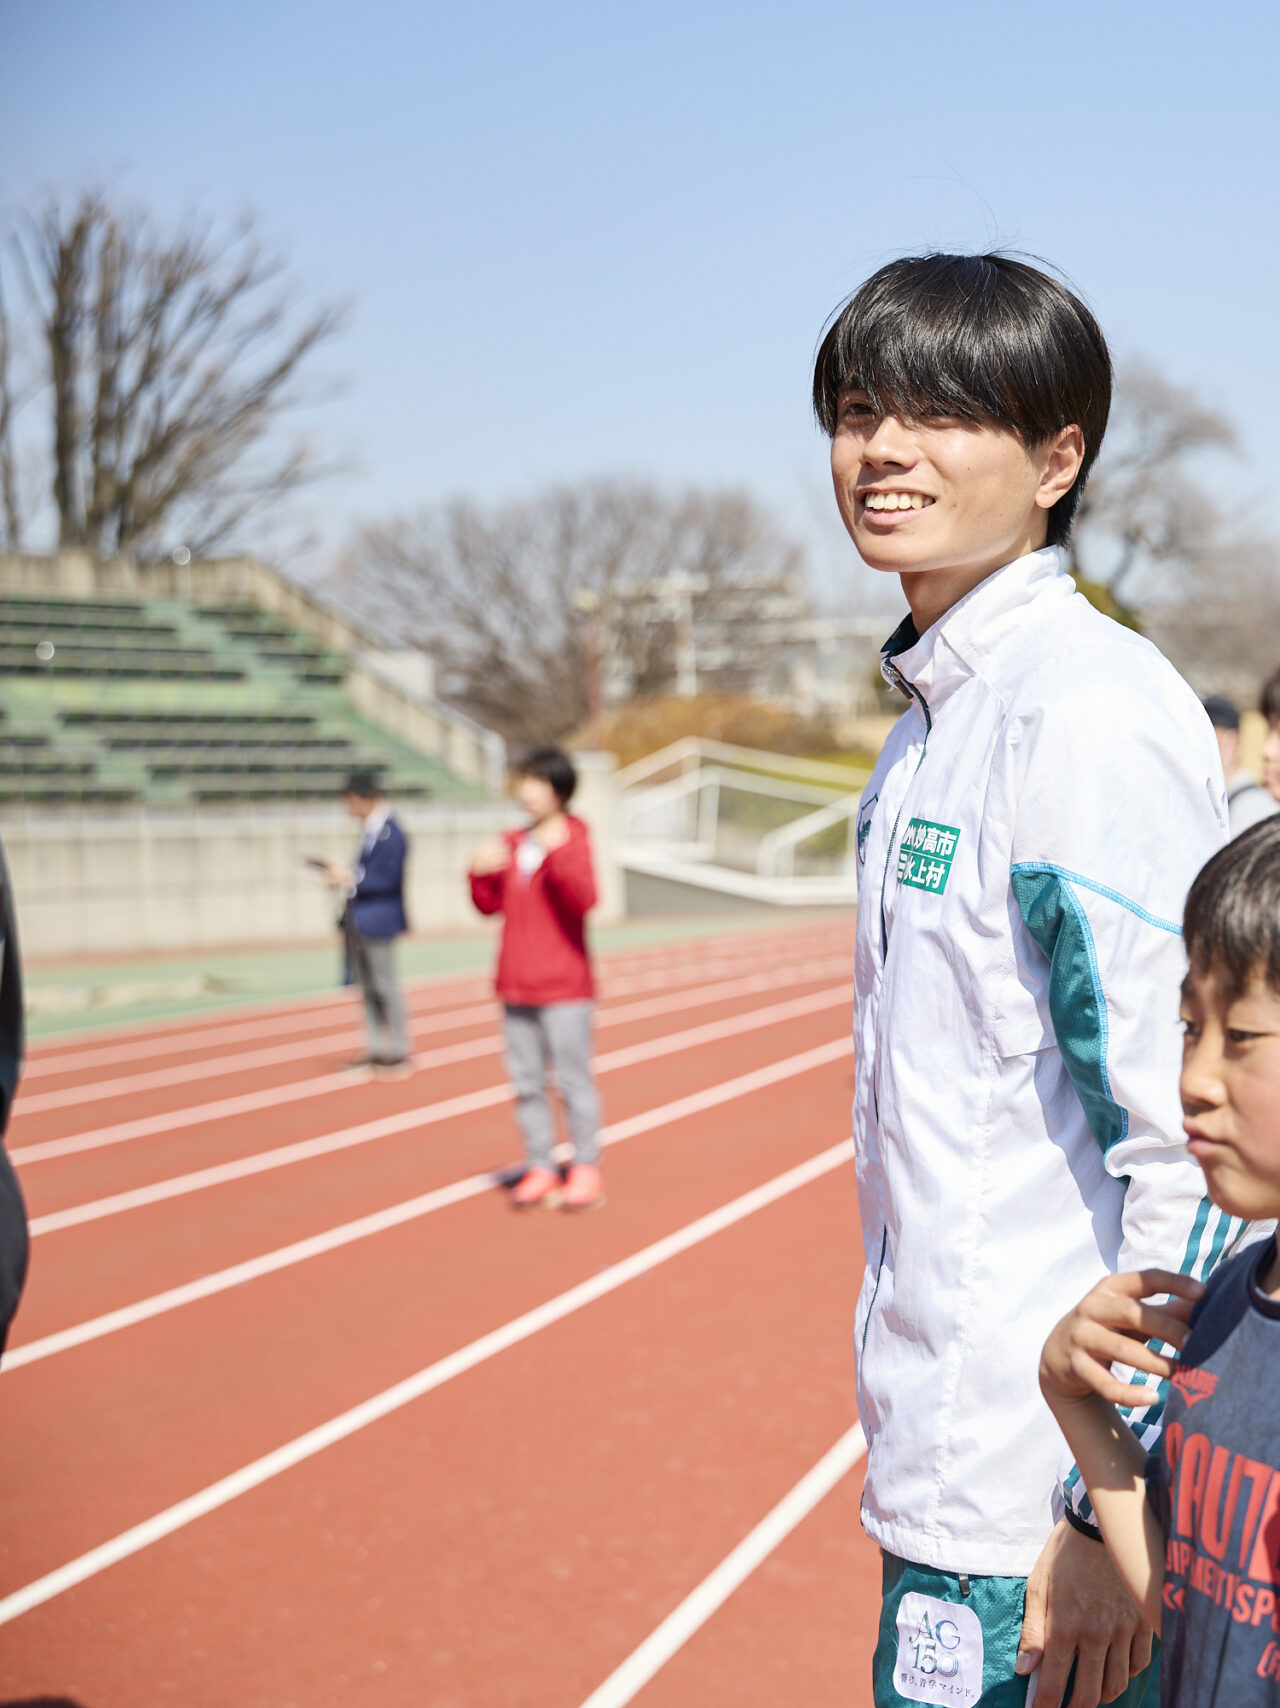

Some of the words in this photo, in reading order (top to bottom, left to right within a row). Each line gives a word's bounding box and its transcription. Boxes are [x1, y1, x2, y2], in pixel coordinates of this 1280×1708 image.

[904, 855, 946, 889] 水上村
[909, 1610, 961, 1650] AG
[912, 1643, 959, 1678] 150
